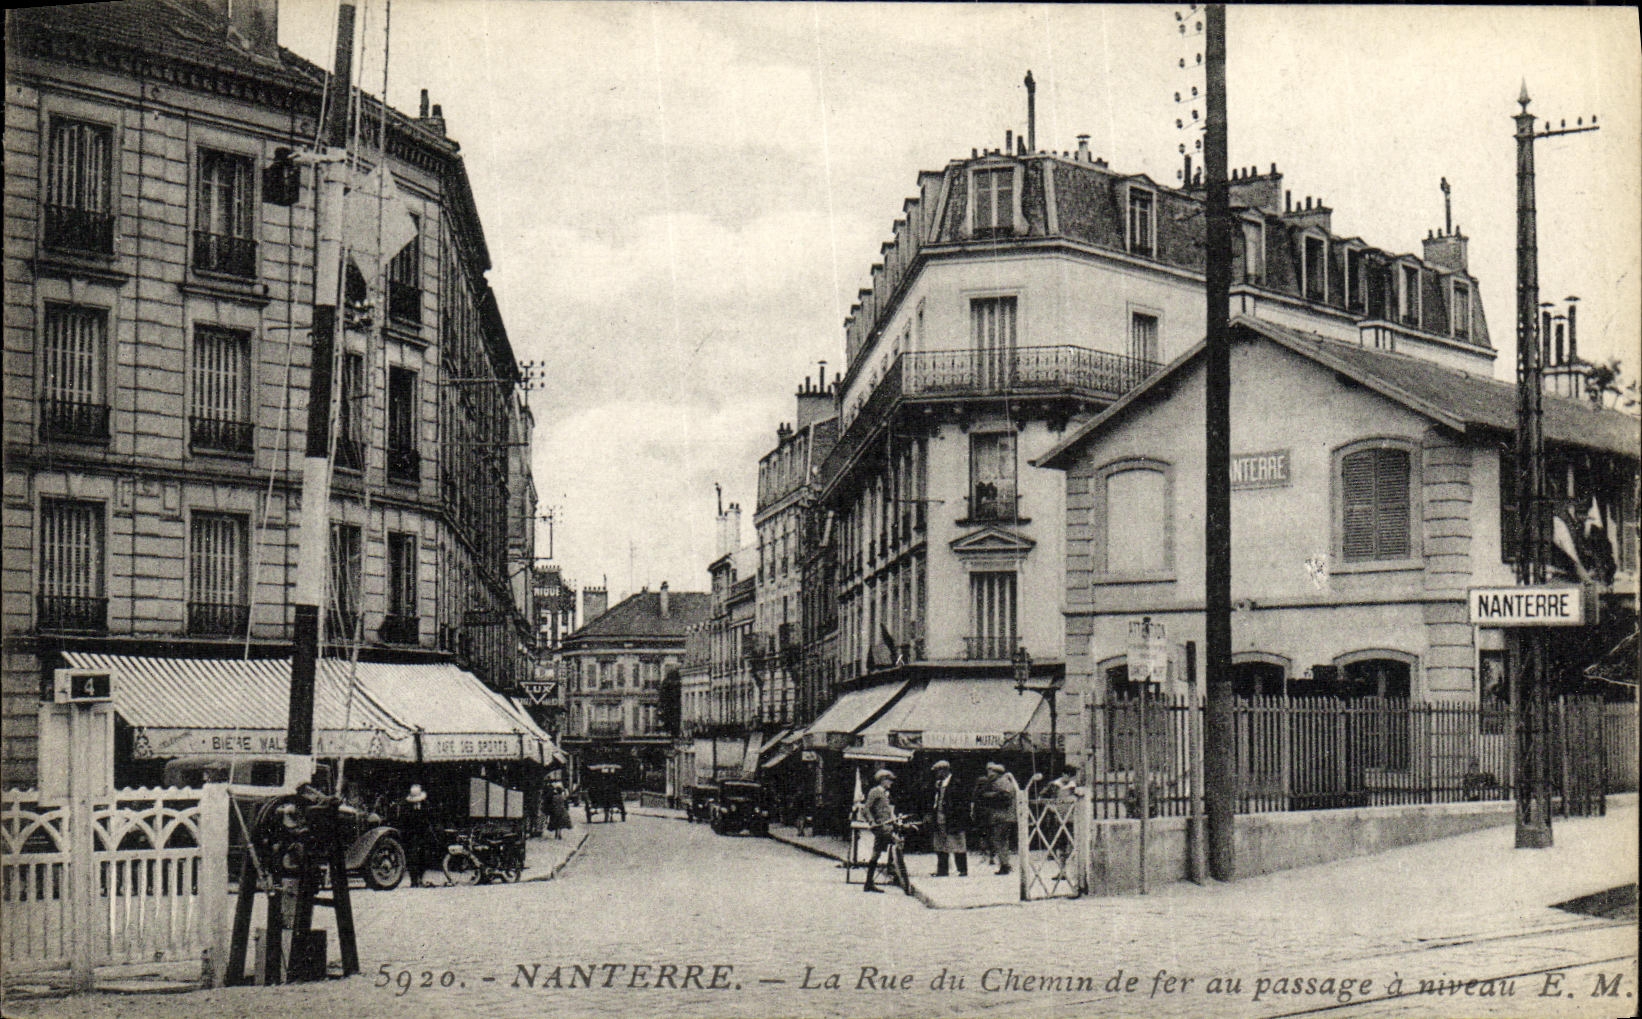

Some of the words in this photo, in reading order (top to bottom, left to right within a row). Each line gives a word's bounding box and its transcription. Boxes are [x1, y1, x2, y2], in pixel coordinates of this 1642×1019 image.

[1229, 455, 1286, 482] NTERRE
[1478, 593, 1570, 618] NANTERRE
[84, 677, 95, 696] 4
[525, 685, 551, 693] LUX
